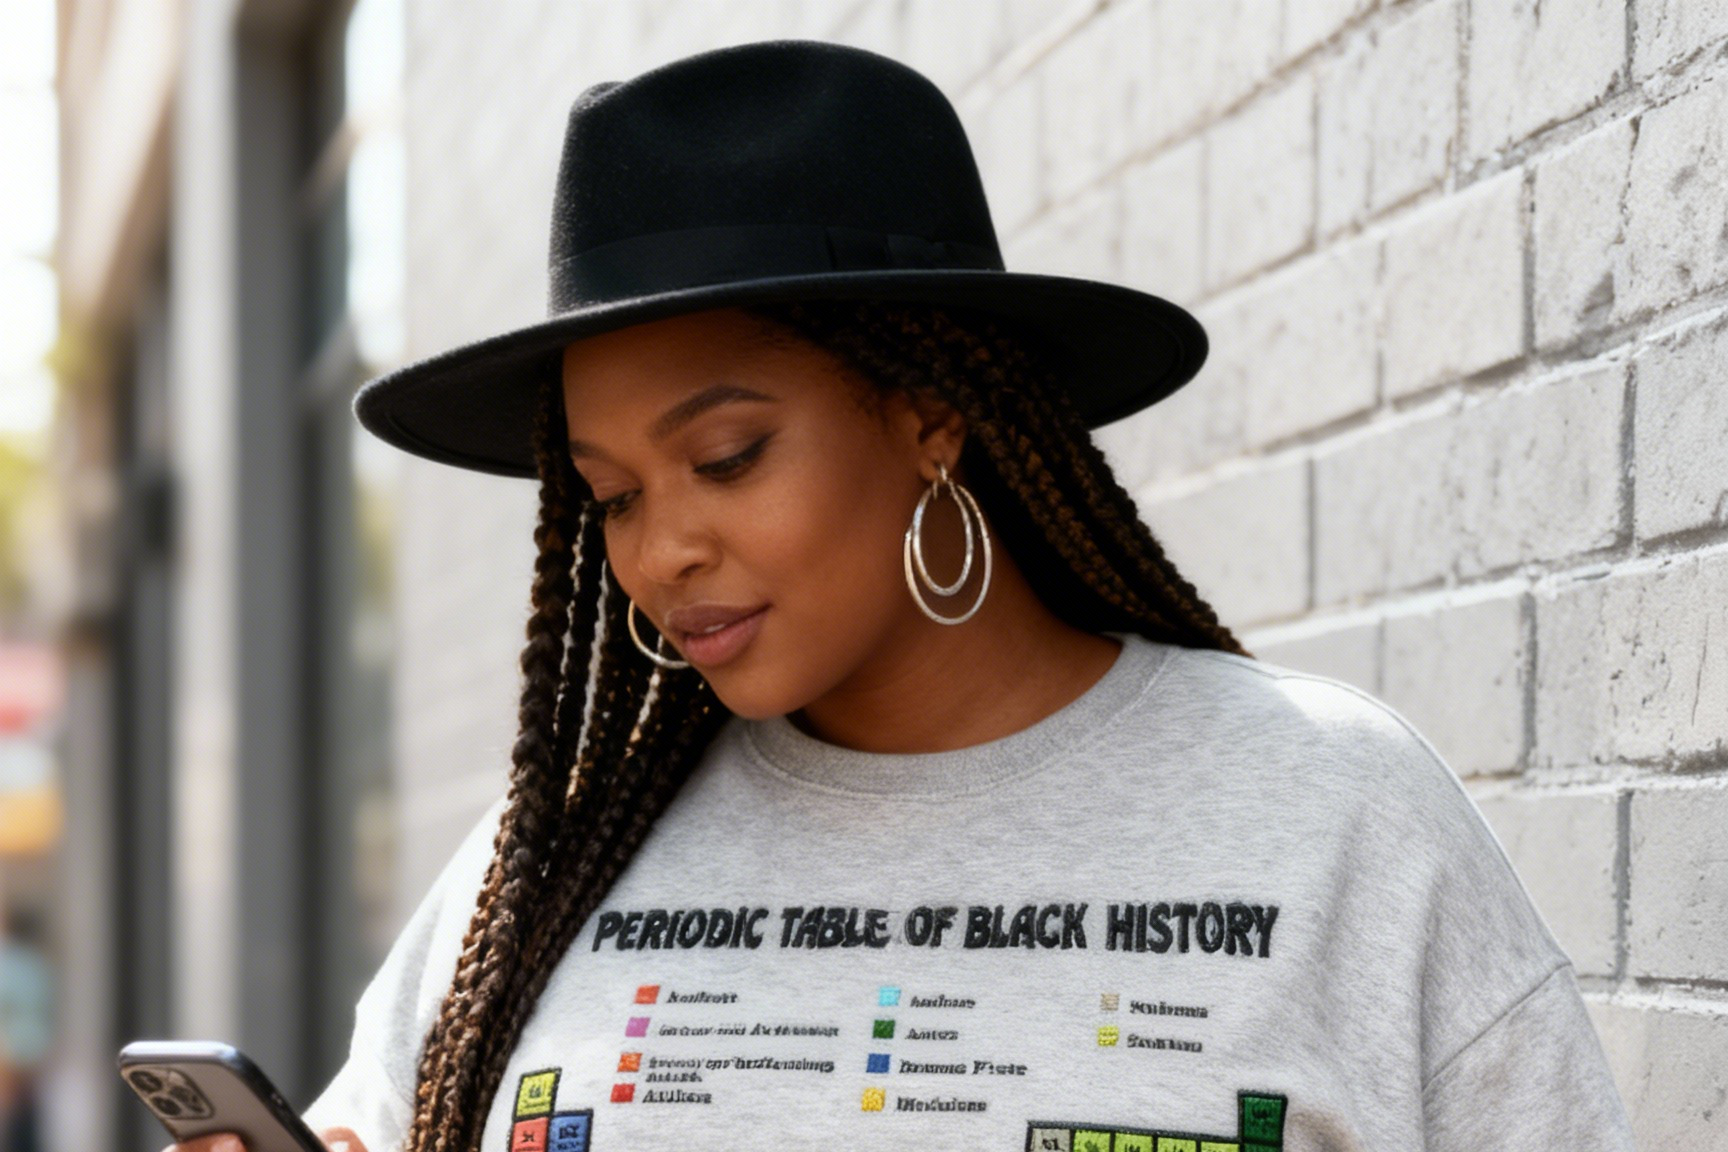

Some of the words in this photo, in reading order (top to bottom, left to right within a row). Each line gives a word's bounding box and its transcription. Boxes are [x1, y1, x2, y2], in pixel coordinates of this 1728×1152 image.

[592, 905, 769, 951] PERIODIC
[780, 906, 891, 949] TABLE
[904, 906, 958, 948] OF
[963, 903, 1088, 949] BLACK
[1105, 902, 1279, 957] HISTORY
